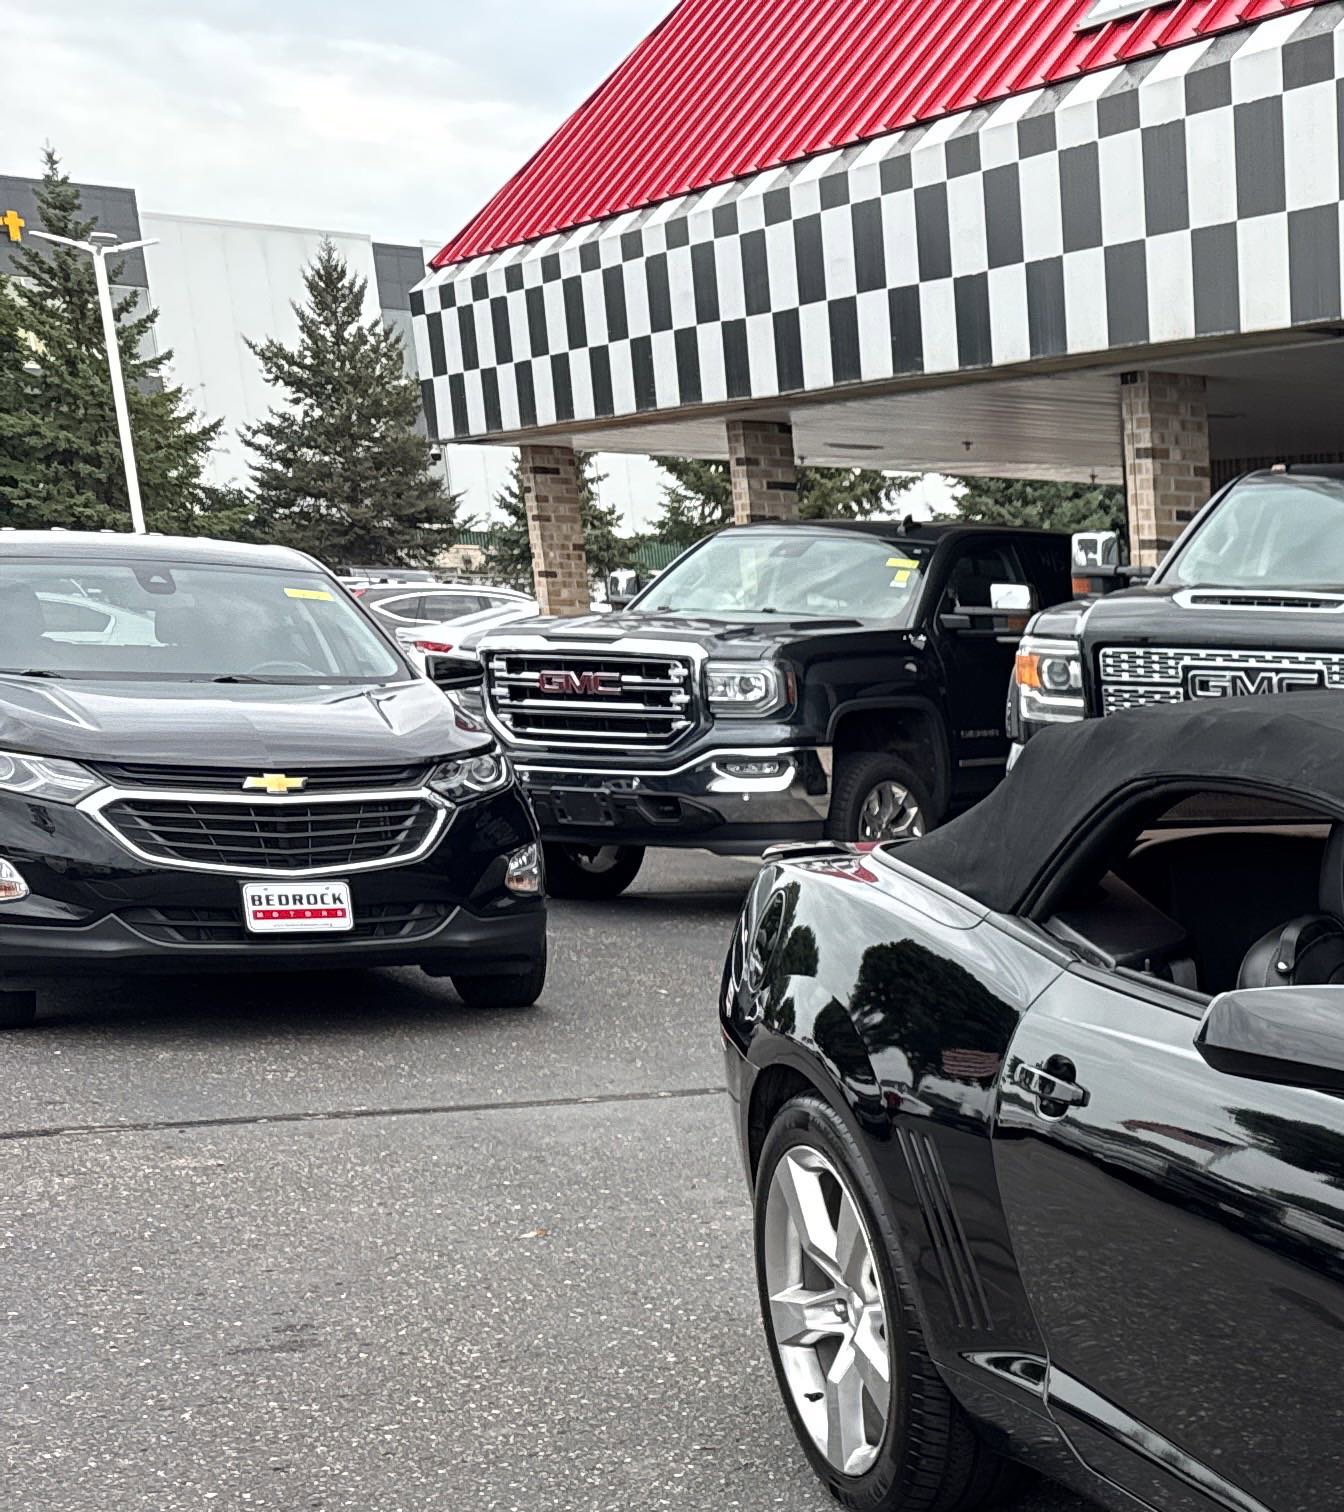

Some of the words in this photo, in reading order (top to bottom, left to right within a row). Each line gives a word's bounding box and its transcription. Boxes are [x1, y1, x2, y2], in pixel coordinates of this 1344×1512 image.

[539, 669, 622, 695] GMC
[1188, 669, 1319, 700] GMC
[250, 892, 344, 906] BEDROCK
[256, 910, 343, 918] MOTORS
